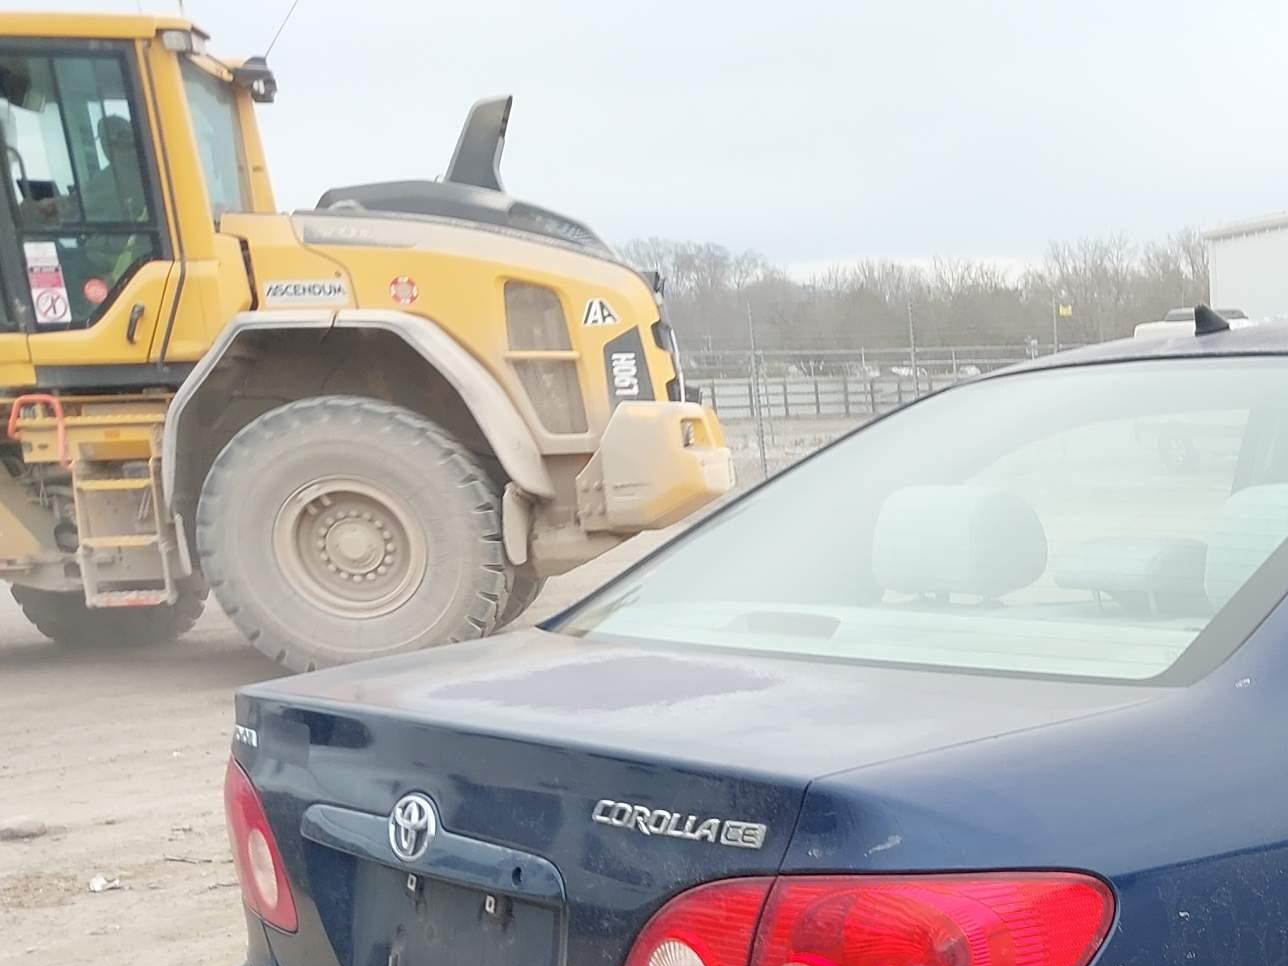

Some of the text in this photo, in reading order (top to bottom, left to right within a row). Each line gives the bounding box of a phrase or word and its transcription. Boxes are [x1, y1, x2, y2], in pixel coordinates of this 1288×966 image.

[265, 282, 346, 298] ASCENDUM
[611, 352, 640, 396] L90H
[591, 799, 764, 847] COROLLA CE
